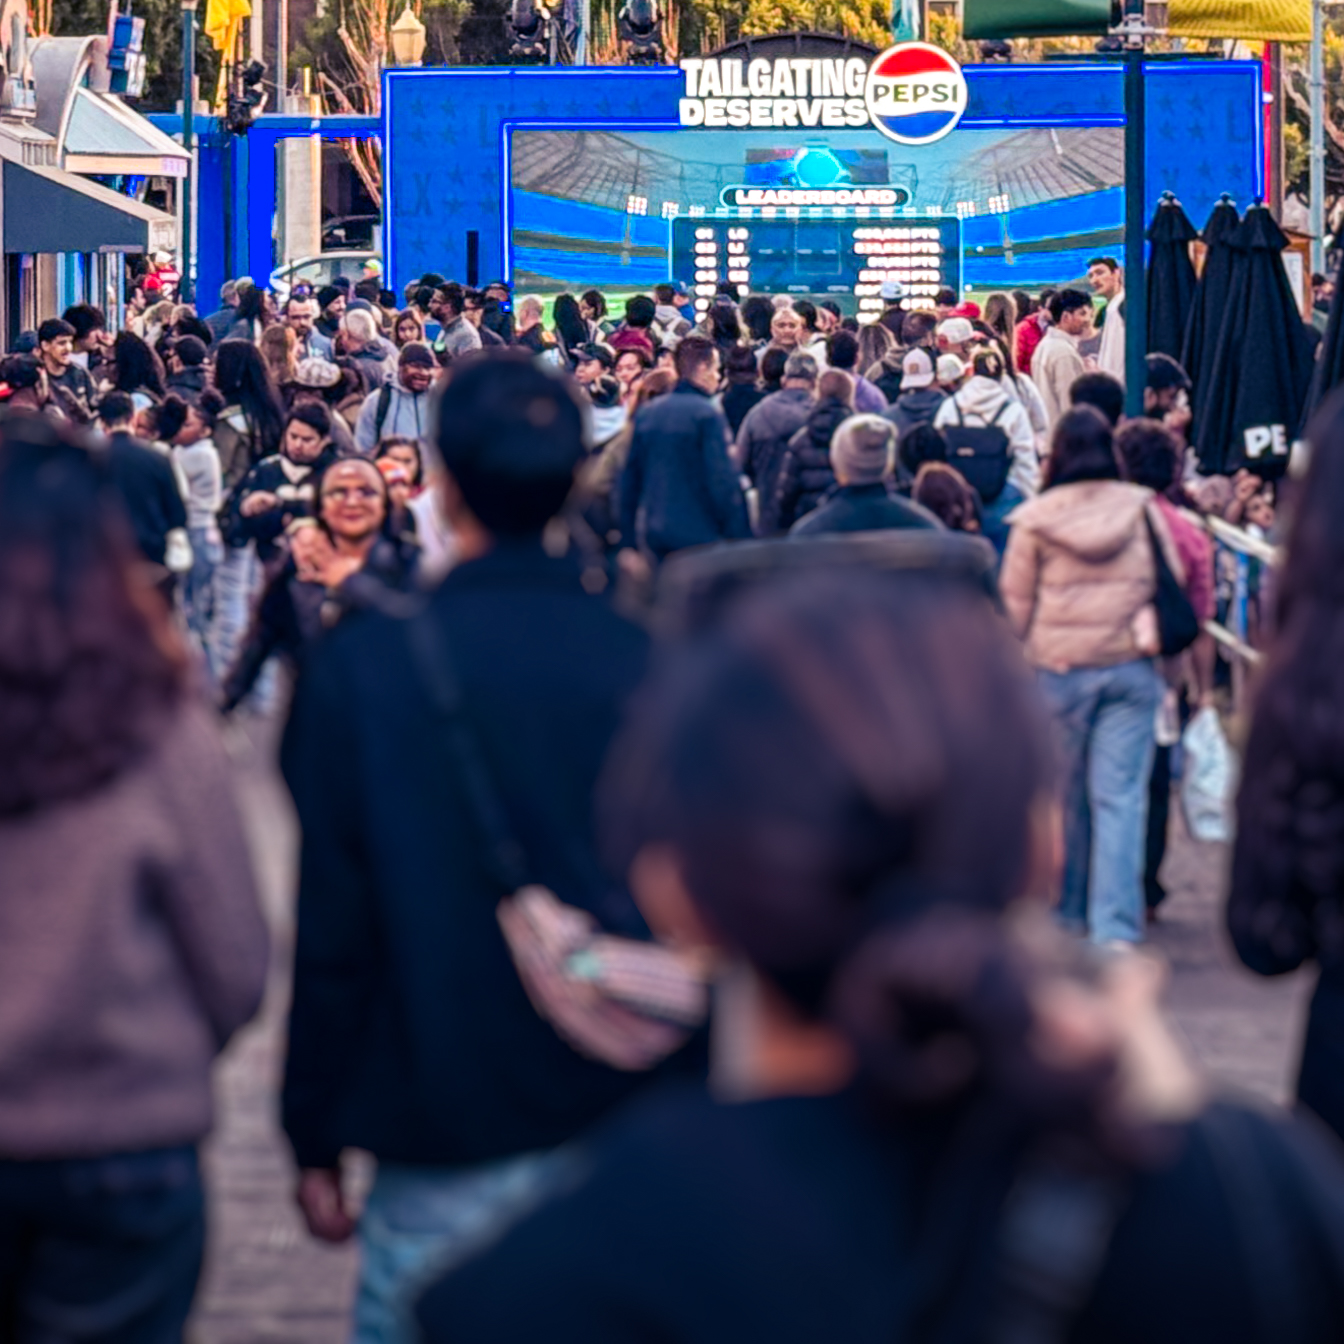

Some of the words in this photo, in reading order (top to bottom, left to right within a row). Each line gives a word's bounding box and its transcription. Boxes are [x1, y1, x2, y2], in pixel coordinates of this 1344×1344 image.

[679, 57, 867, 97] TAILGATING
[873, 83, 959, 104] PEPSI
[679, 98, 870, 127] DESERVES
[734, 189, 898, 205] LEADERBOARD
